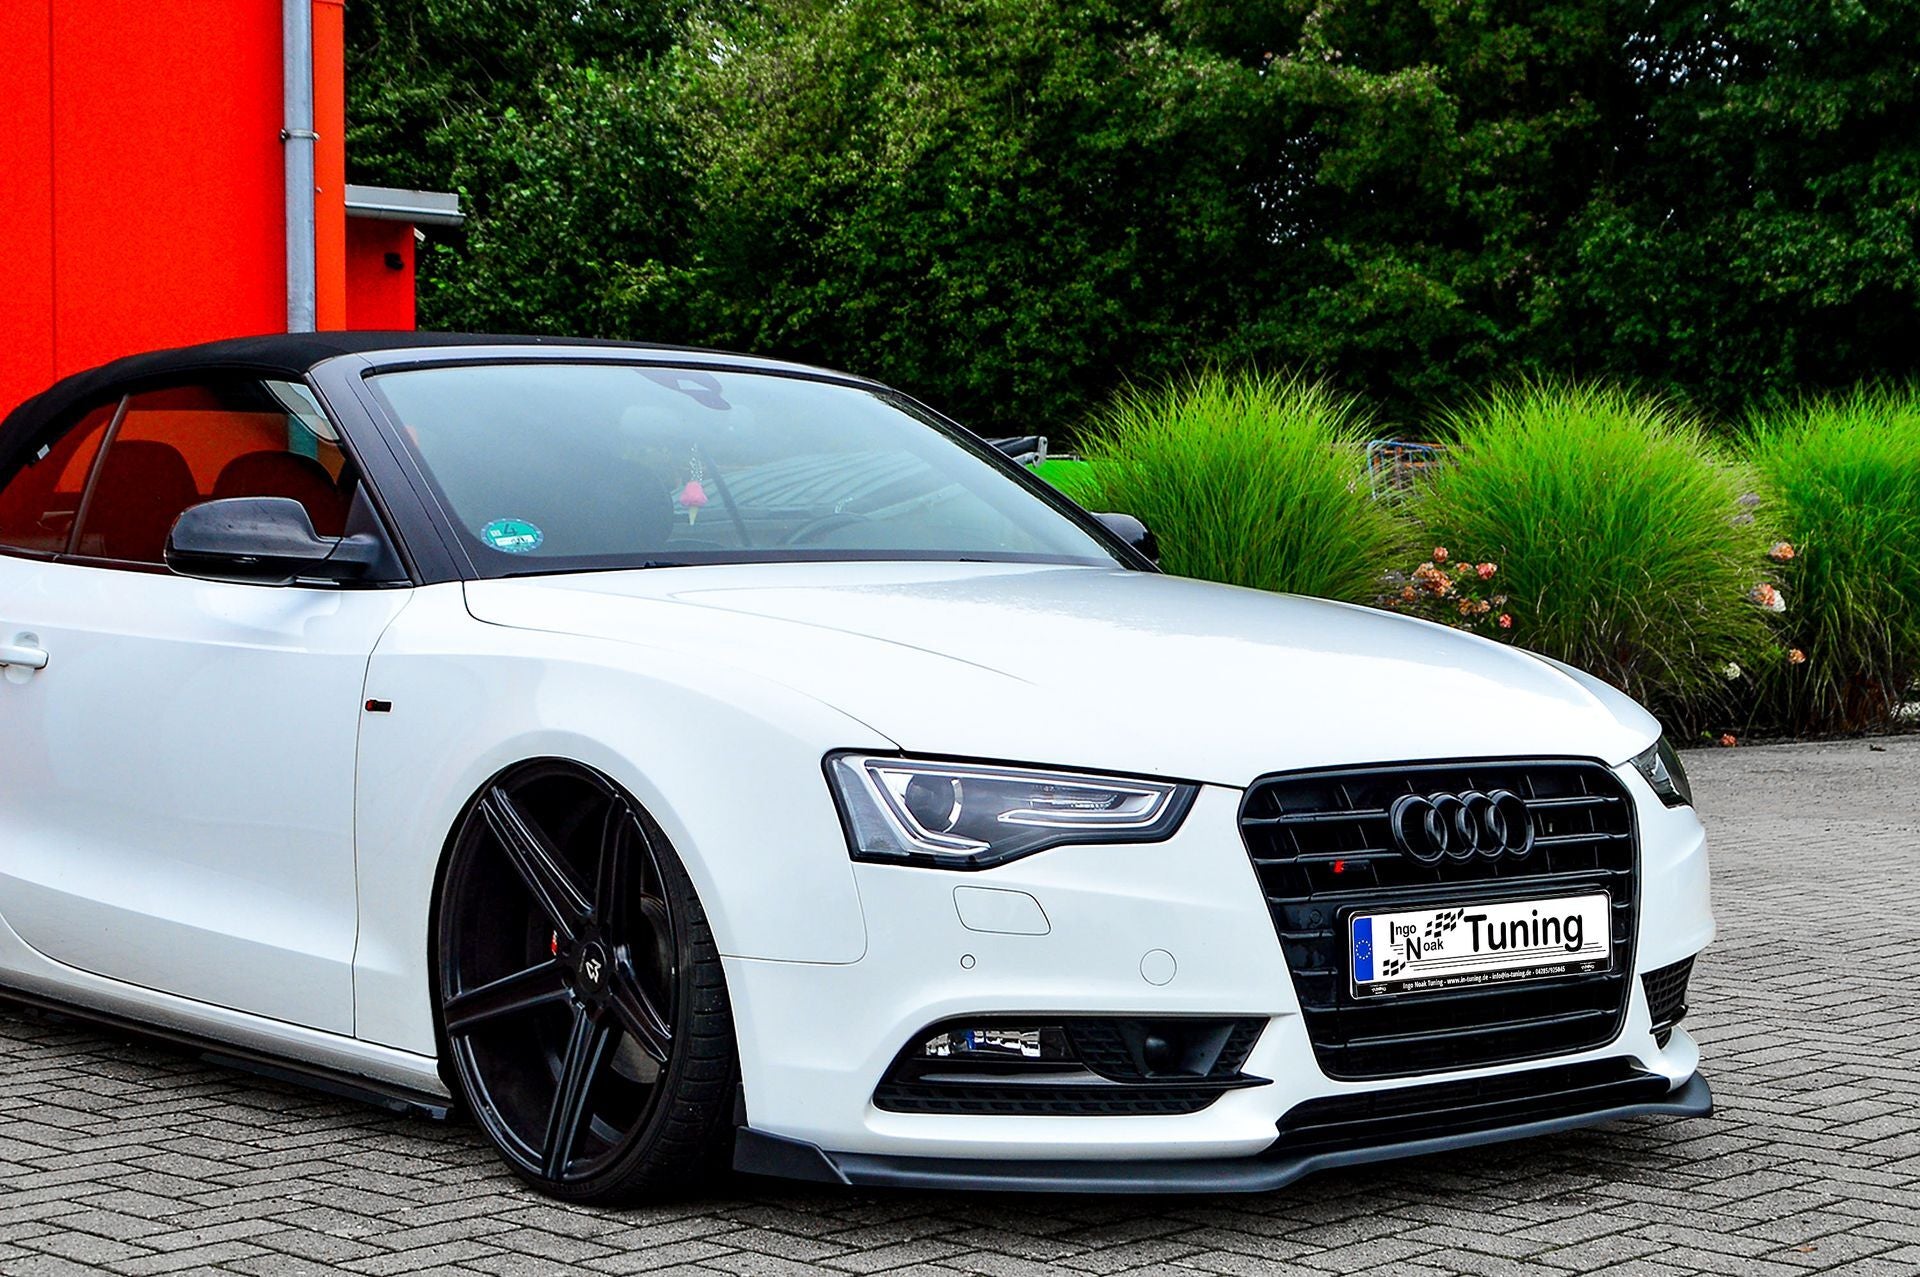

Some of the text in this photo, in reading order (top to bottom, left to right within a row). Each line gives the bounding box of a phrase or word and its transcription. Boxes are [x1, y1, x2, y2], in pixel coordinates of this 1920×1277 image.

[1390, 921, 1416, 944] Ingo
[1463, 909, 1583, 952] Tuning
[1406, 936, 1444, 960] Noak
[1402, 982, 1414, 990] Ingo
[1414, 980, 1427, 988] Noak
[1428, 979, 1443, 987] Tuning
